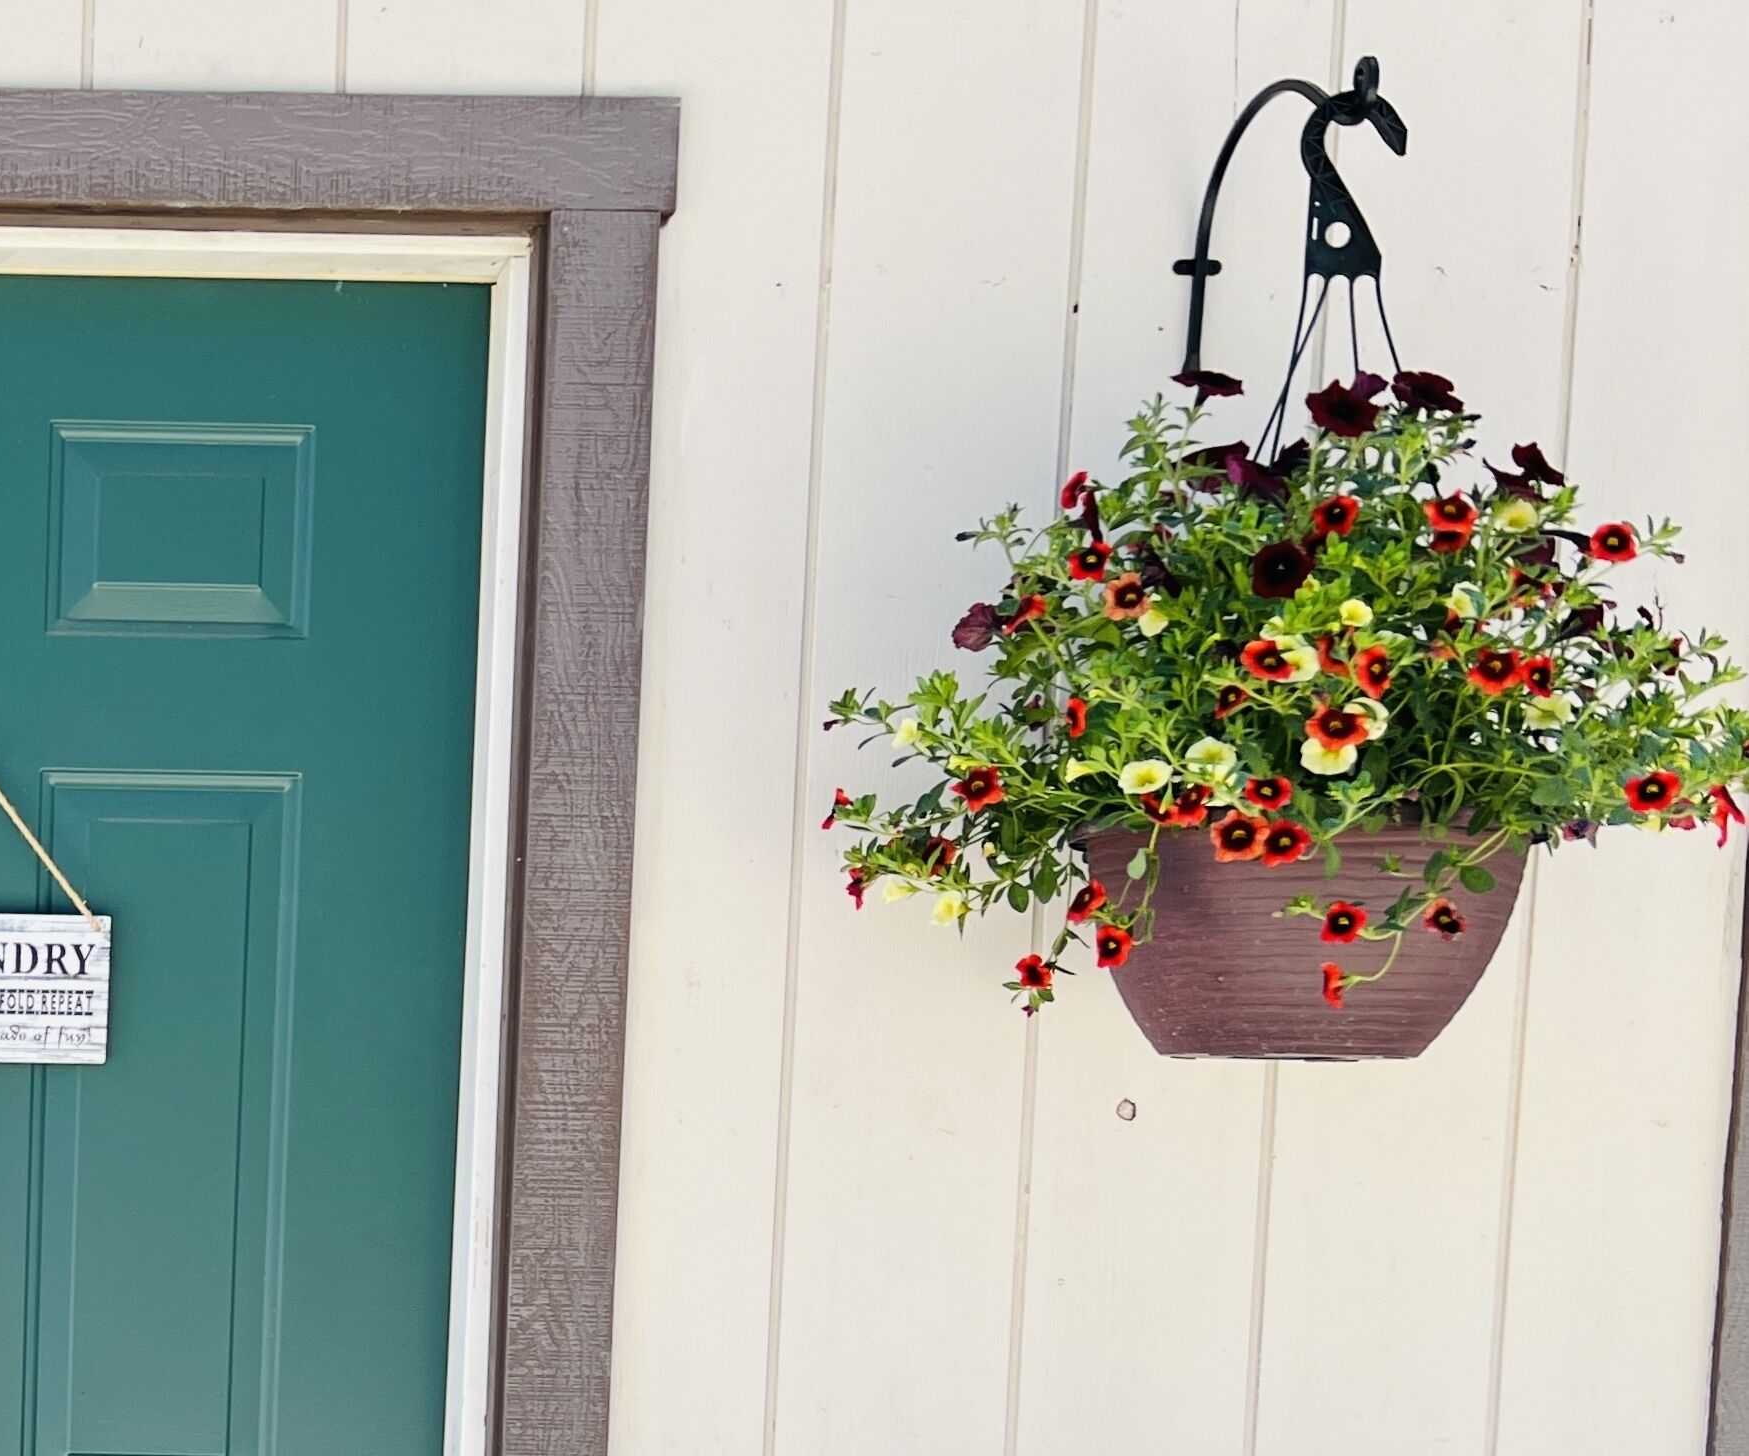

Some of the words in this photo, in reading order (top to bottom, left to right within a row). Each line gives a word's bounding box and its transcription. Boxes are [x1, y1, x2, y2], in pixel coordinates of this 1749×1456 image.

[0, 993, 35, 1011] FOLD
[42, 994, 94, 1012] REPEAT
[34, 1026, 51, 1049] of
